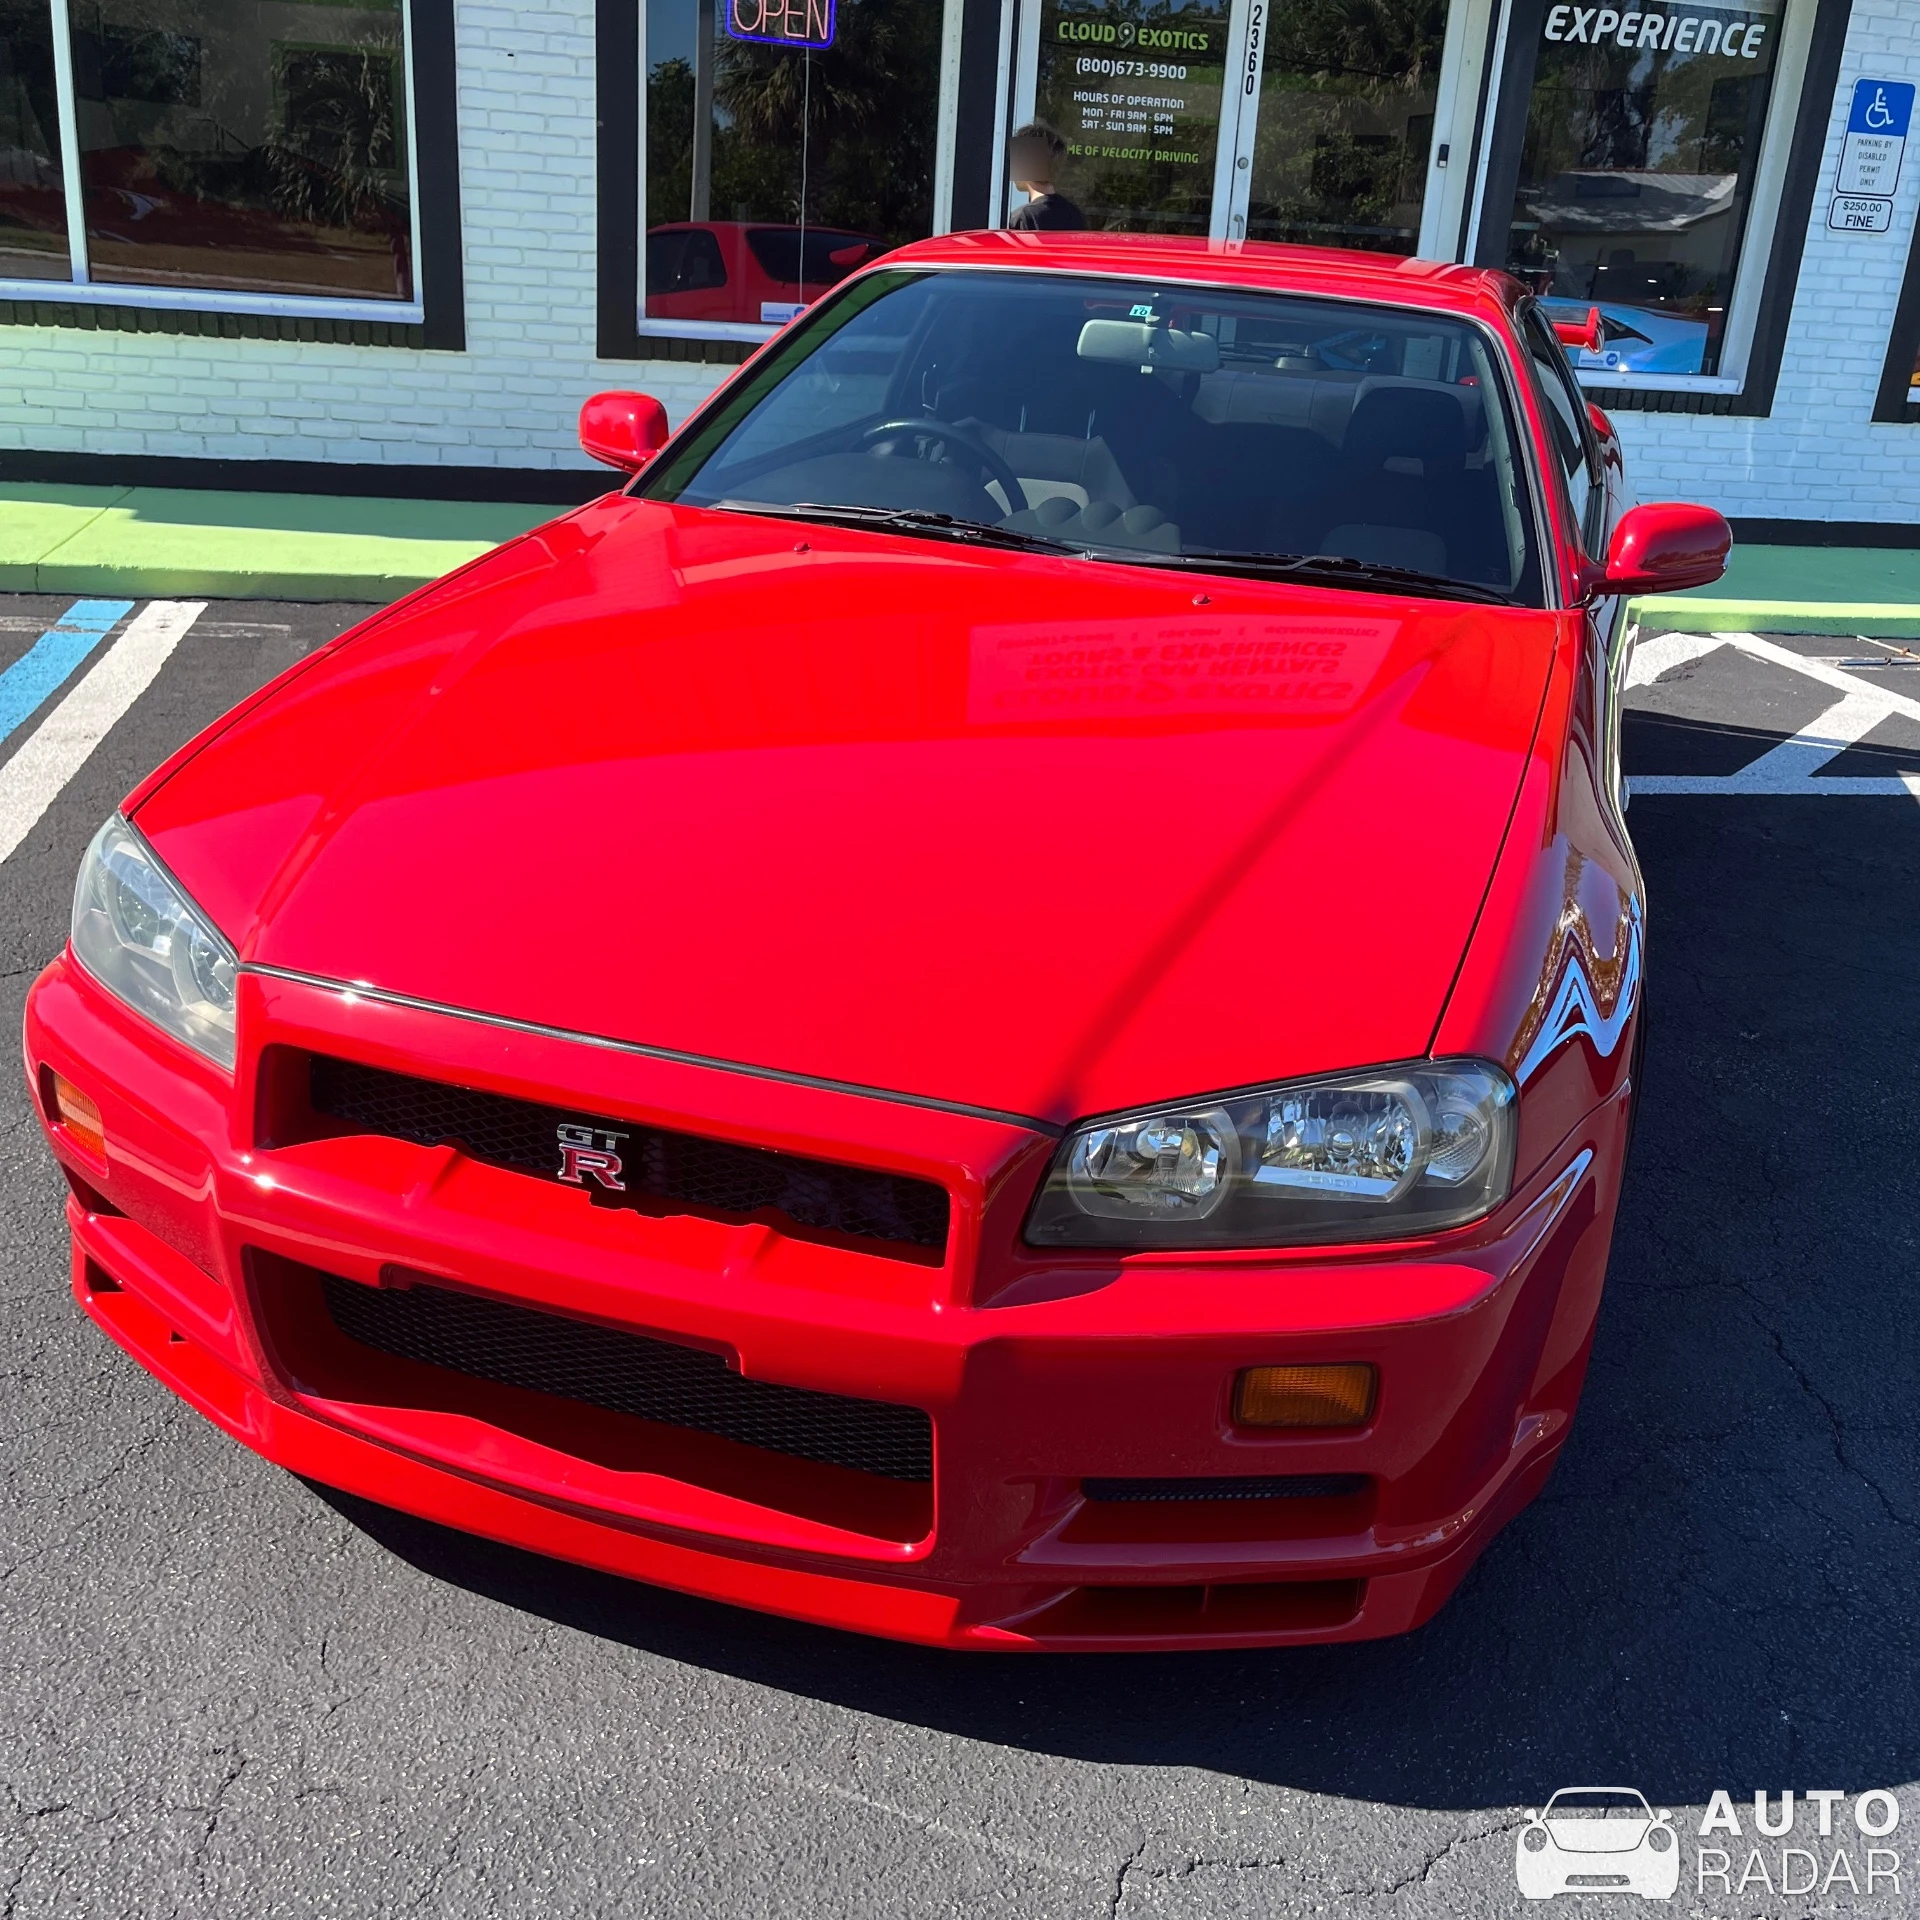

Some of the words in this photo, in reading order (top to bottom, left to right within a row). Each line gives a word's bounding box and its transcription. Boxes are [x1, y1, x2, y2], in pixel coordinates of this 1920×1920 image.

[734, 0, 829, 39] OPEN
[1058, 21, 1116, 42] CLOUD
[1118, 22, 1136, 49] 9
[1138, 28, 1209, 50] EXOTICS
[1545, 5, 1766, 59] EXPERIENCE
[1245, 4, 1263, 95] 2360
[1076, 57, 1187, 79] (800)673-9900
[1073, 91, 1109, 104] HOURS
[1111, 94, 1125, 105] OF
[1127, 96, 1185, 109] OPERATION
[1082, 107, 1104, 118] MON
[1110, 110, 1125, 119] FRI
[1127, 111, 1147, 121] 9AM
[1154, 113, 1174, 123] 6PM
[1081, 120, 1100, 130] SAT
[1106, 121, 1125, 132] SUN
[1127, 123, 1147, 133] 9AM
[1154, 125, 1173, 135] 5PM
[1857, 139, 1882, 148] PARKING
[1884, 141, 1893, 149] BY
[1084, 145, 1099, 156] OF
[1102, 147, 1153, 160] VELOCITY
[1155, 150, 1199, 164] DRIVING
[1858, 152, 1887, 161] DISABLED
[1859, 165, 1881, 174] PERMIT
[1860, 178, 1875, 186] ONLY
[1843, 201, 1882, 212] $250.00
[1845, 214, 1874, 228] FINE
[556, 1123, 630, 1151] GT
[557, 1142, 626, 1191] R
